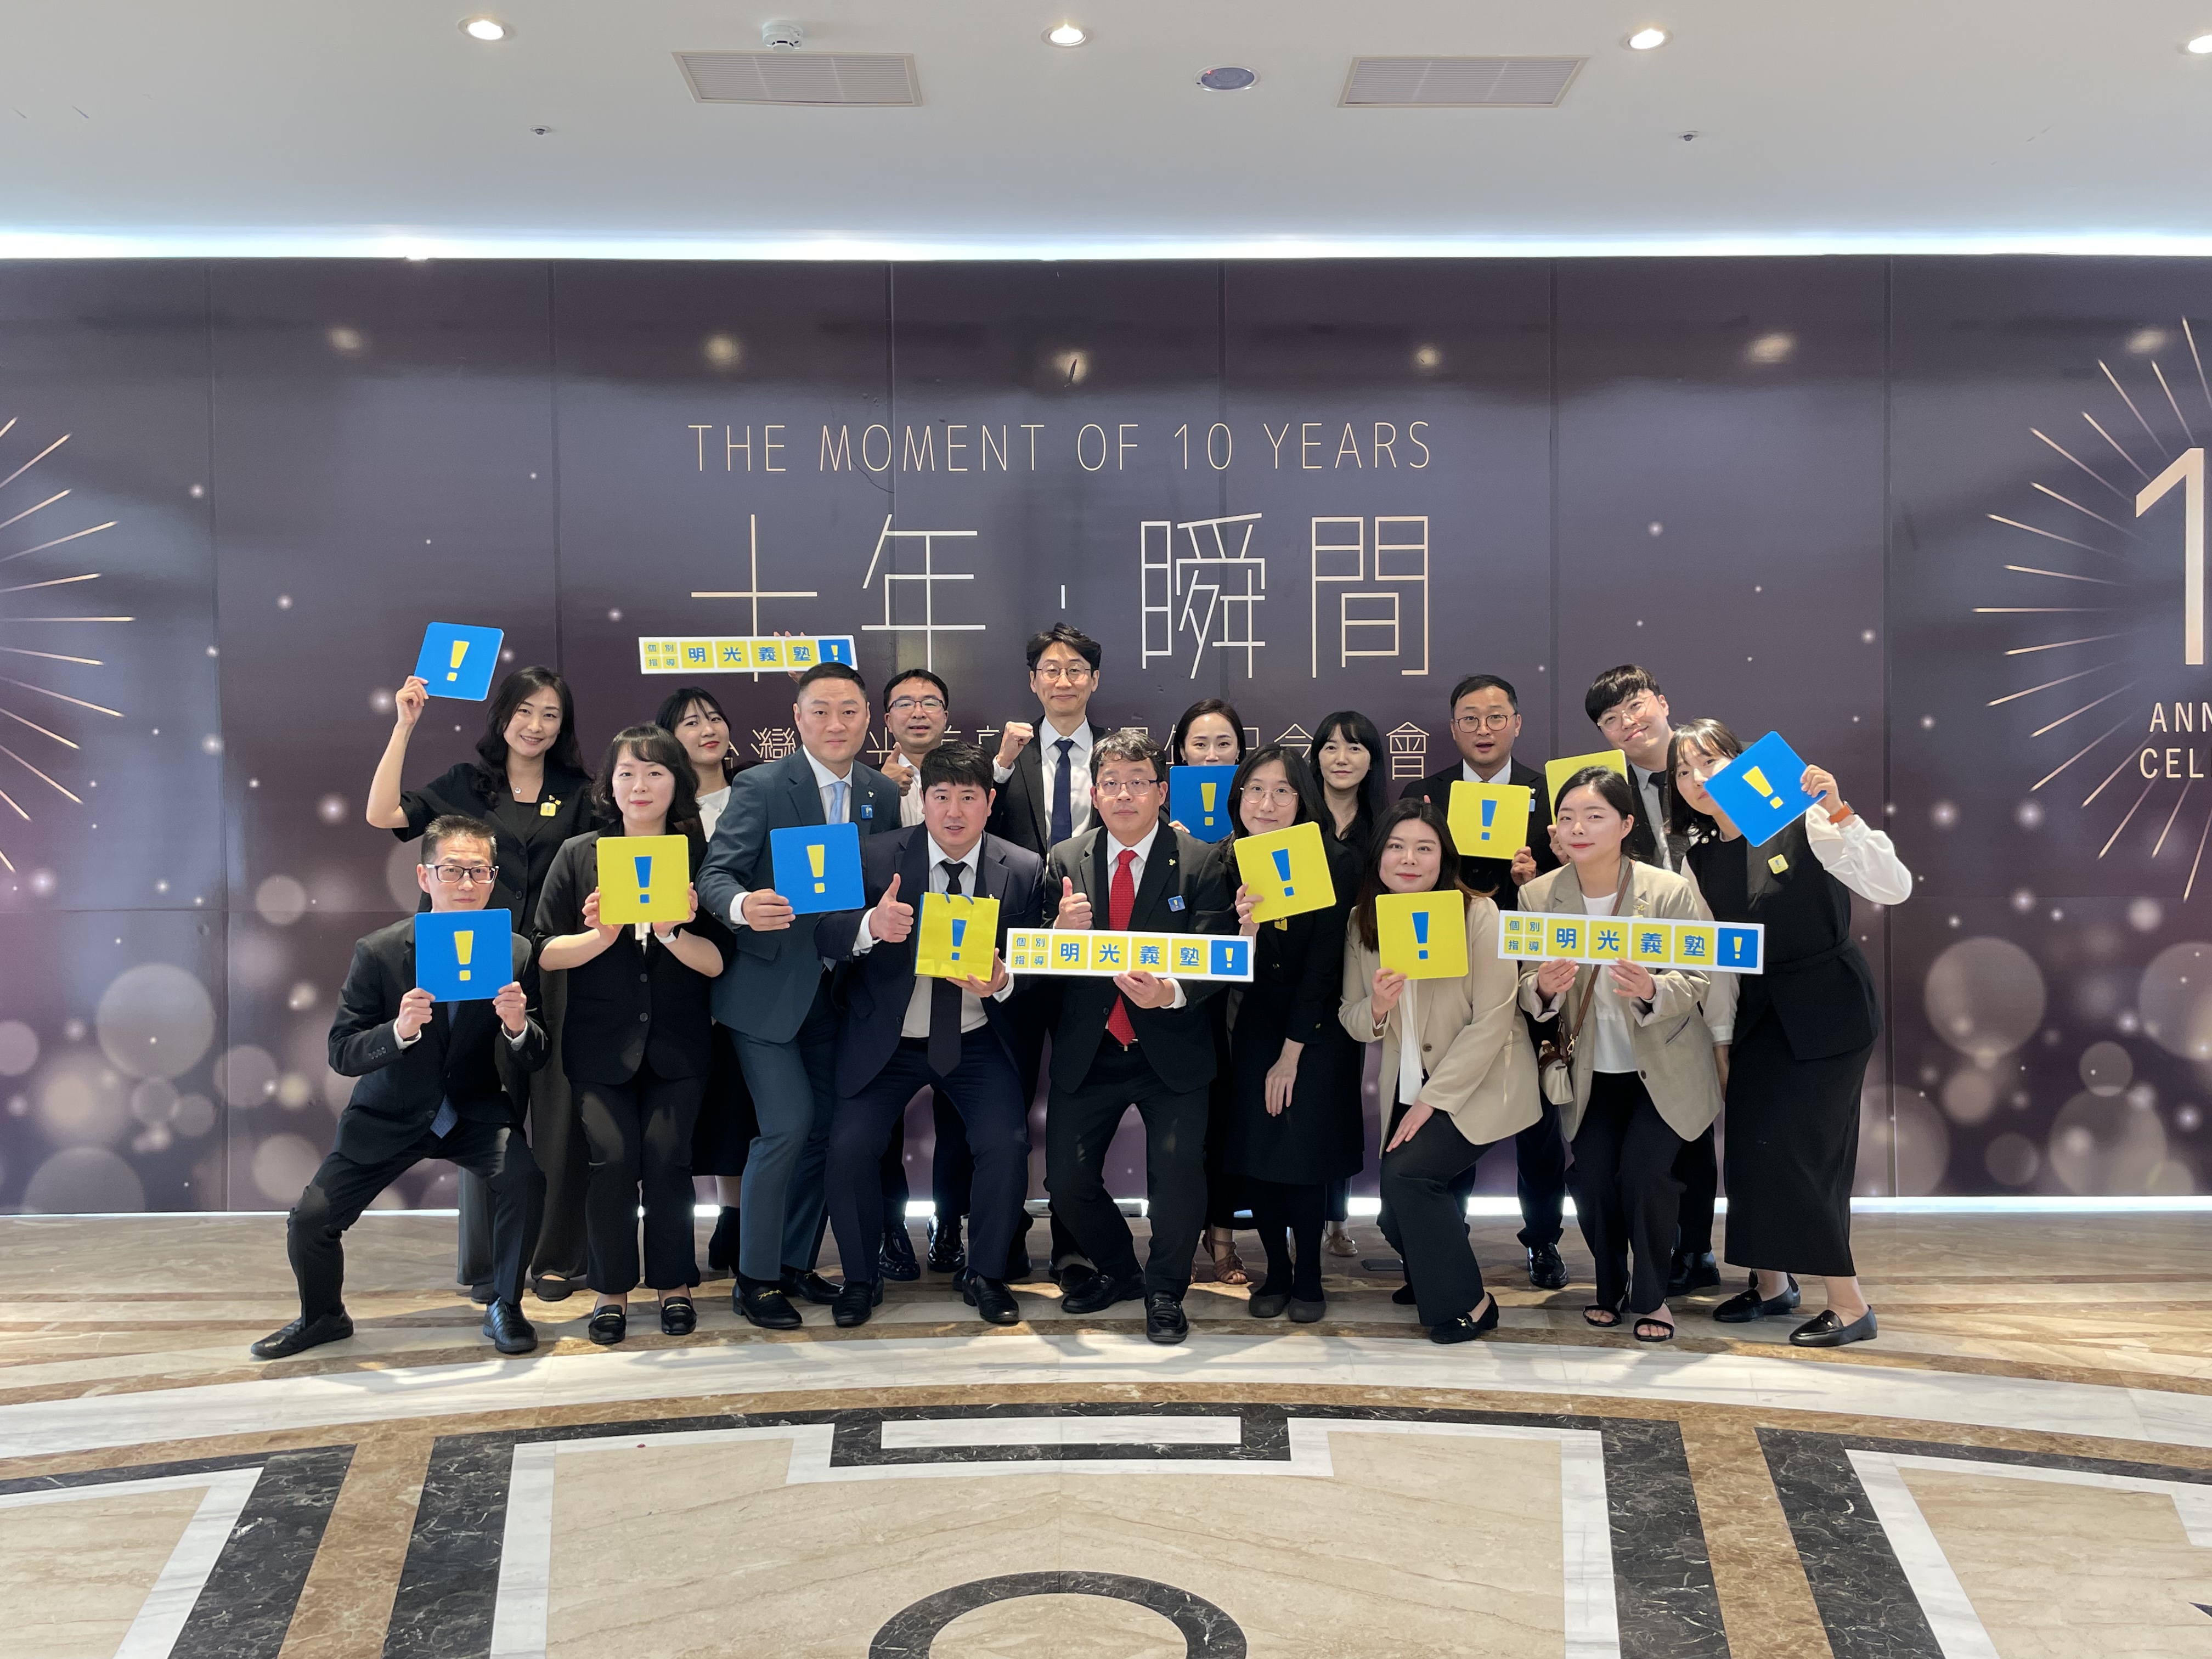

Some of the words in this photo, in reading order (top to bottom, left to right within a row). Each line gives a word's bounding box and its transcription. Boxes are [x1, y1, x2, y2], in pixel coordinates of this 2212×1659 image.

[688, 425, 786, 471] THE
[819, 424, 1045, 471] MOMENT
[1077, 424, 1138, 471] OF
[1175, 423, 1232, 470] 10
[1263, 421, 1430, 469] YEARS
